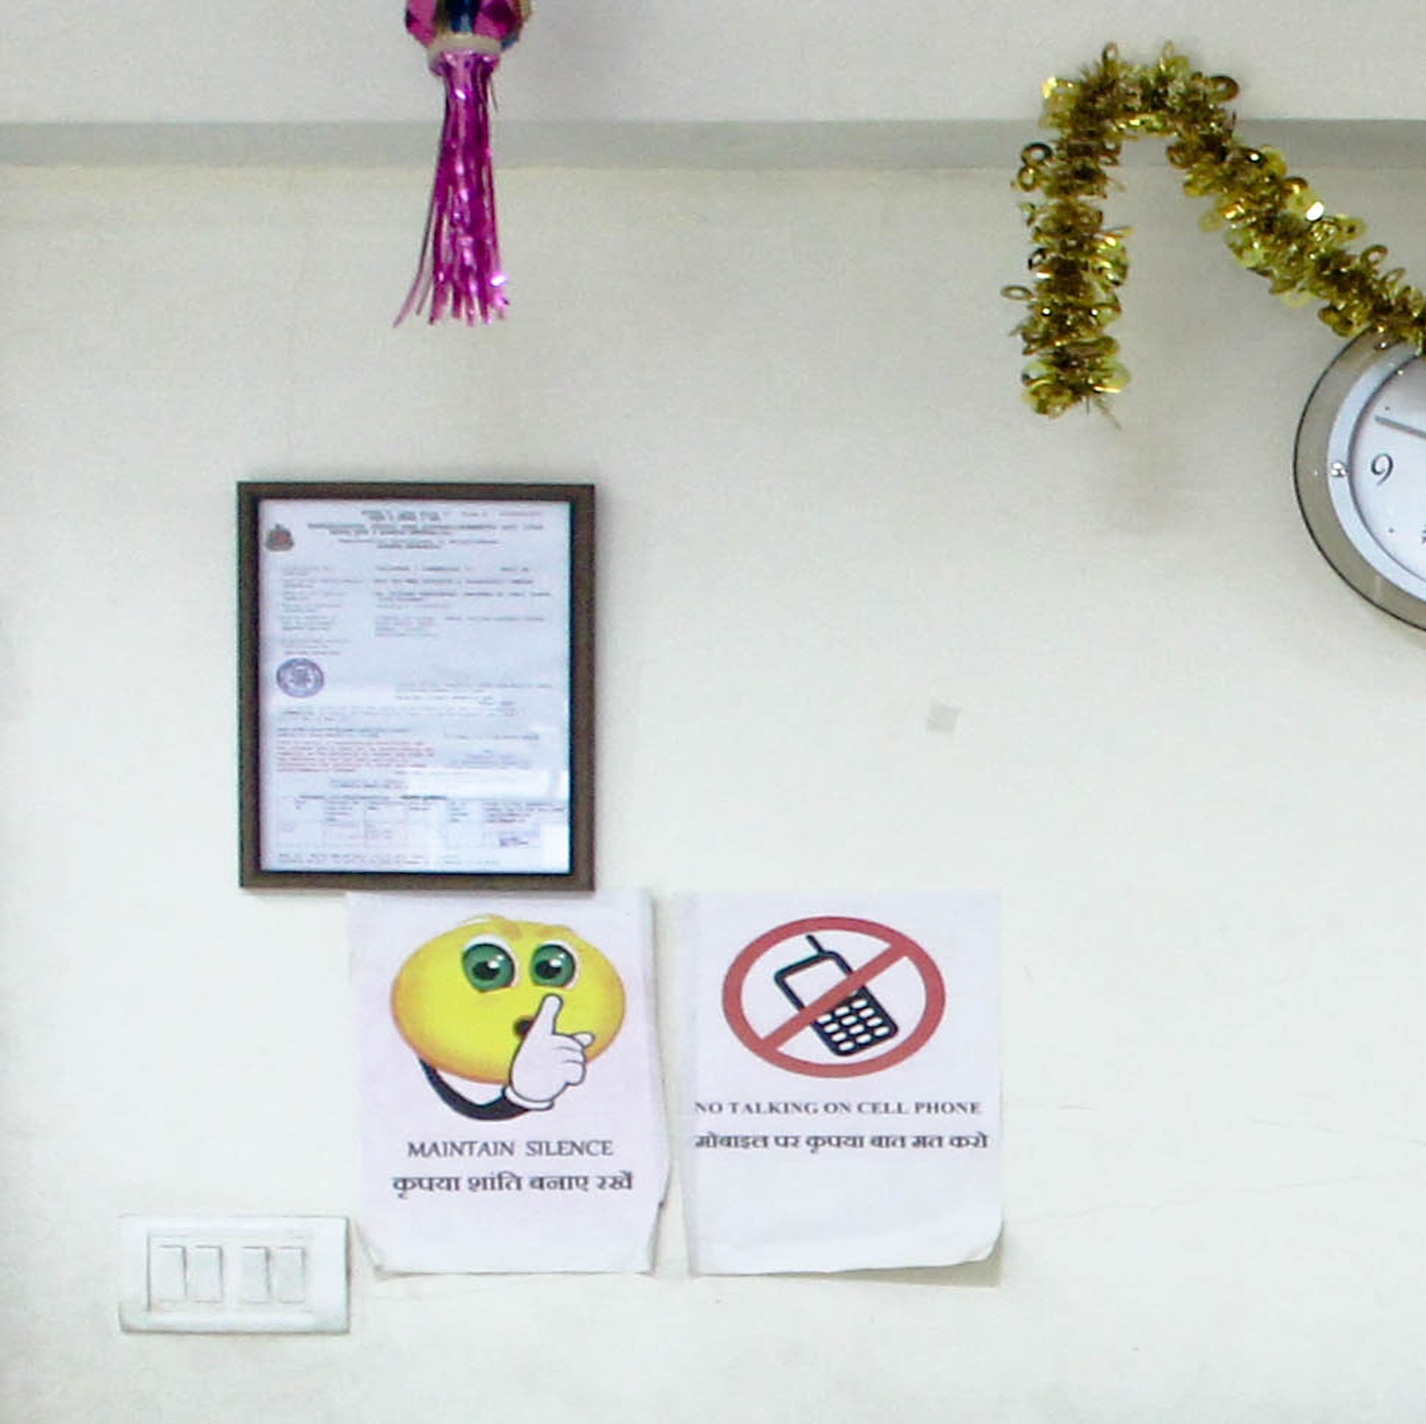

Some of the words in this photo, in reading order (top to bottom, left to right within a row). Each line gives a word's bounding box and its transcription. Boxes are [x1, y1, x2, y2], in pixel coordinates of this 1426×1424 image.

[1370, 453, 1394, 486] 9
[695, 1102, 722, 1115] NO
[728, 1102, 819, 1115] TALKING
[823, 1102, 852, 1115] ON
[857, 1102, 909, 1115] CELL
[914, 1102, 983, 1115] PHONE
[407, 1140, 515, 1158] MAINTAIN
[526, 1140, 614, 1157] SILENCE
[695, 1131, 768, 1149] मोबाइल
[774, 1134, 799, 1148] पर
[805, 1134, 864, 1153] कृपया
[870, 1134, 907, 1148] बात
[911, 1134, 944, 1148] मत
[950, 1131, 989, 1148] करो
[392, 1175, 460, 1199] कृपया
[468, 1171, 522, 1191] शांति
[529, 1174, 589, 1191] बनाए
[596, 1170, 634, 1191] रखें
